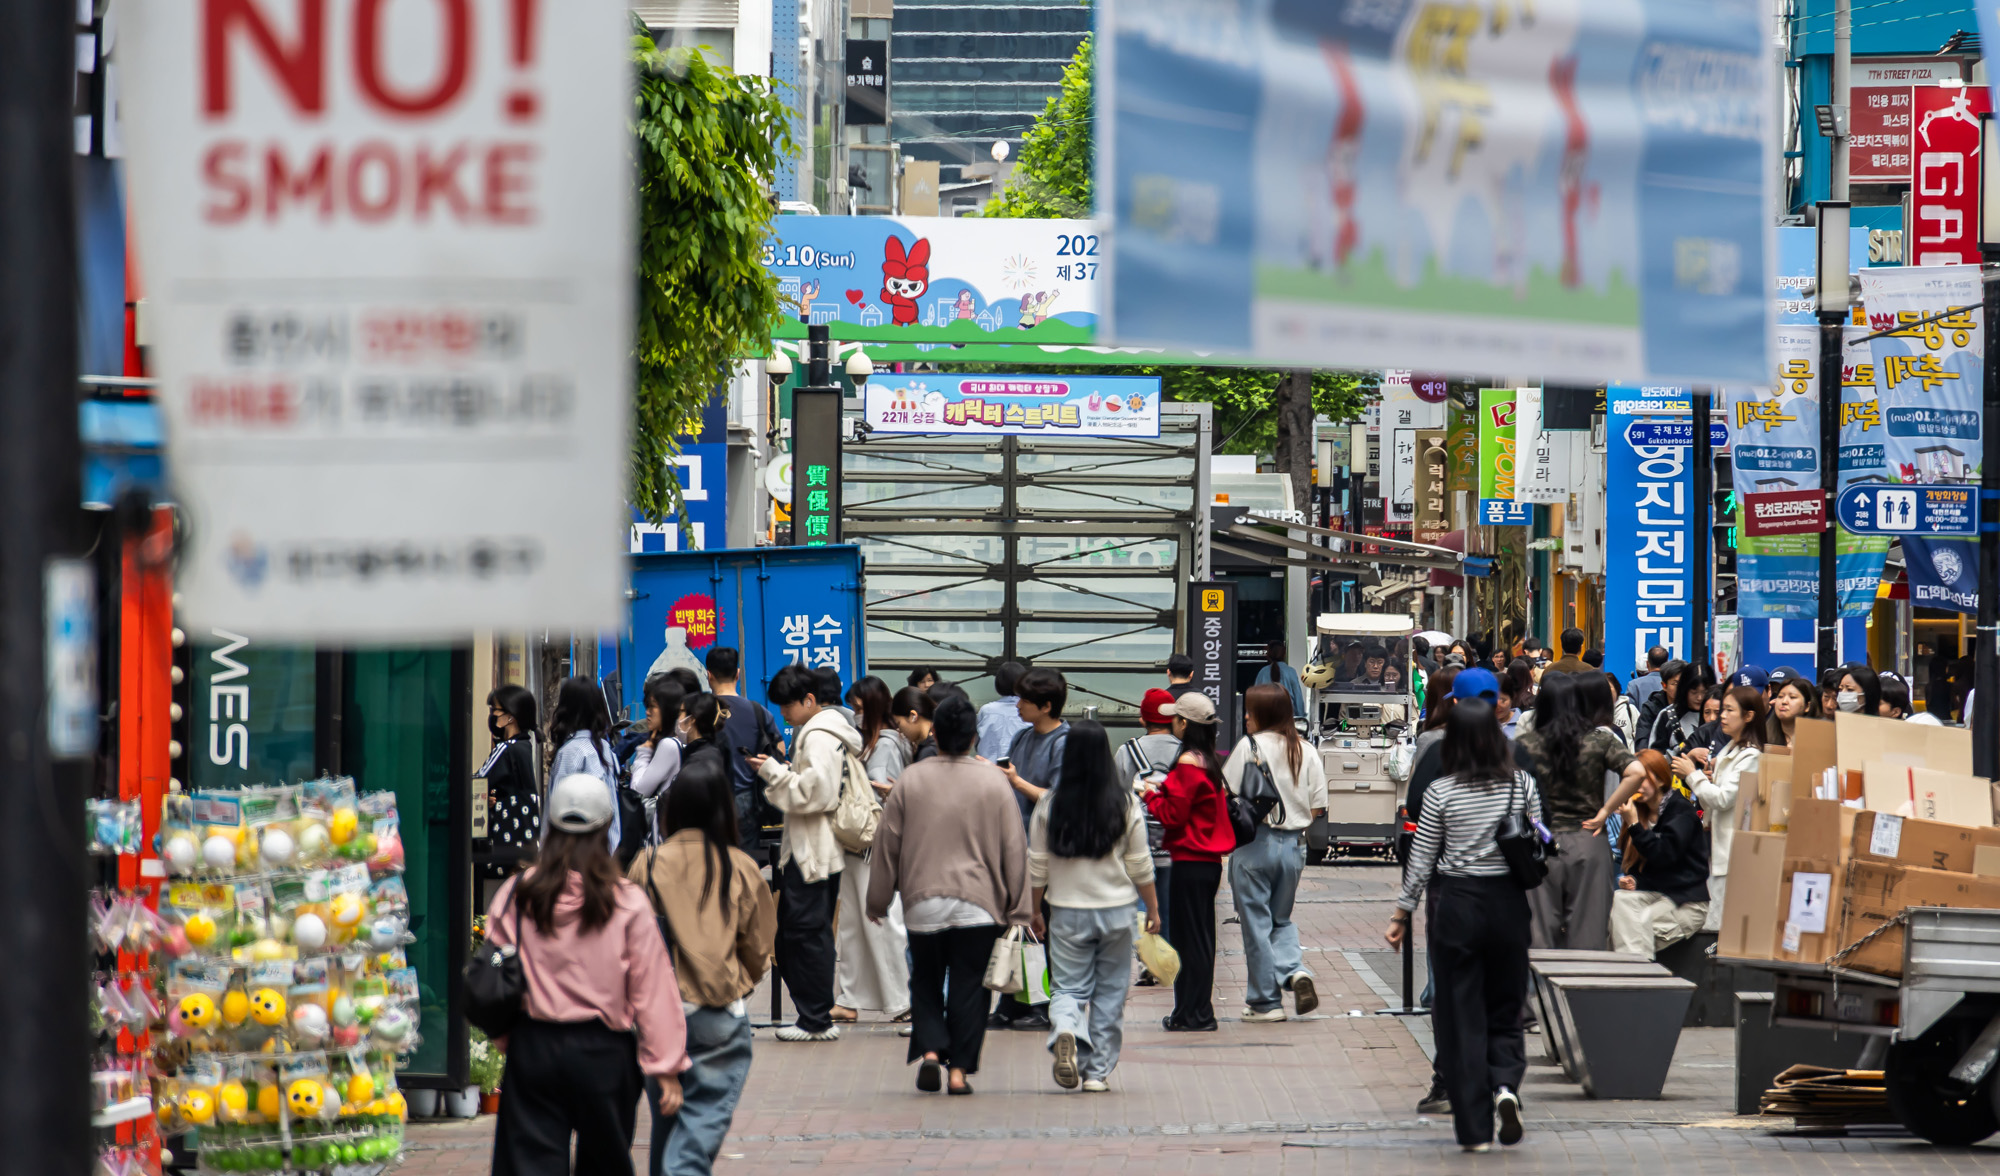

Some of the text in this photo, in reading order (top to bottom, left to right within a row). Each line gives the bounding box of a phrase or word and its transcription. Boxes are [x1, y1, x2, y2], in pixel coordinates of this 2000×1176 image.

[201, 0, 545, 122] NO!
[1868, 69, 1932, 80] 7TH STREET PIZZA
[1868, 94, 1909, 107] 1인용 피자
[1882, 115, 1909, 127] 파스타
[1849, 134, 1908, 147] 오븐치즈떡볶이
[200, 141, 544, 224] SMOKE
[1056, 265, 1071, 281] 제
[882, 411, 935, 424] 22개 상점
[944, 398, 1079, 426] 캐릭터 스트리트
[1631, 431, 1645, 439] 591
[1710, 431, 1726, 439] 595
[1428, 464, 1443, 512] 럭셔리
[1926, 490, 1968, 501] 개방화장실
[1487, 501, 1526, 523] 폼프
[1755, 500, 1821, 518] 동성로관광특구
[1855, 511, 1869, 519] 지하
[676, 609, 716, 624] 빈병 회수
[687, 623, 716, 636] 서비스
[780, 614, 842, 646] 생수
